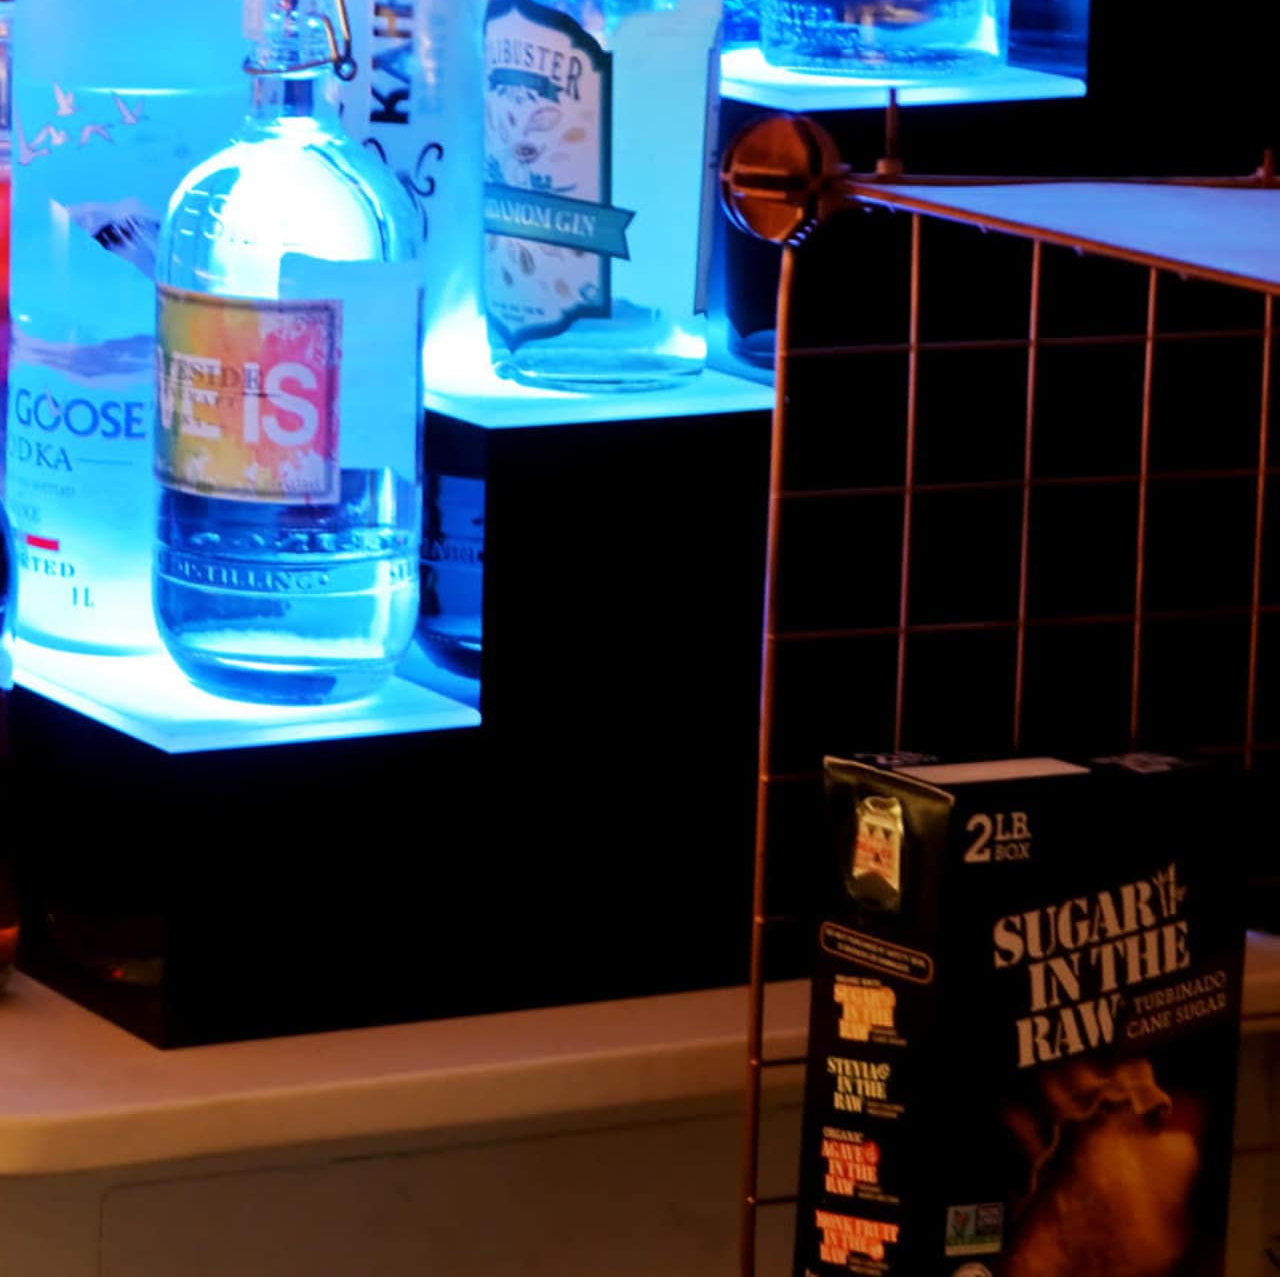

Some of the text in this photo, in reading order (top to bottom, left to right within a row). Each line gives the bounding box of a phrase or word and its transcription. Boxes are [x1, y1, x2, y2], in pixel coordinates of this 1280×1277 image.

[490, 40, 583, 102] LIBUSTER
[554, 211, 597, 237] GIN
[15, 388, 147, 440] GOOSE
[156, 344, 320, 446] VE IS
[963, 813, 992, 864] 2
[994, 841, 1031, 861] BOX
[992, 879, 1157, 970] SUGAR
[1028, 919, 1191, 1013] IN THE
[1133, 970, 1227, 1014] TURBINADO
[1015, 993, 1122, 1069] RAW
[1126, 993, 1228, 1039] CANE SUGAR
